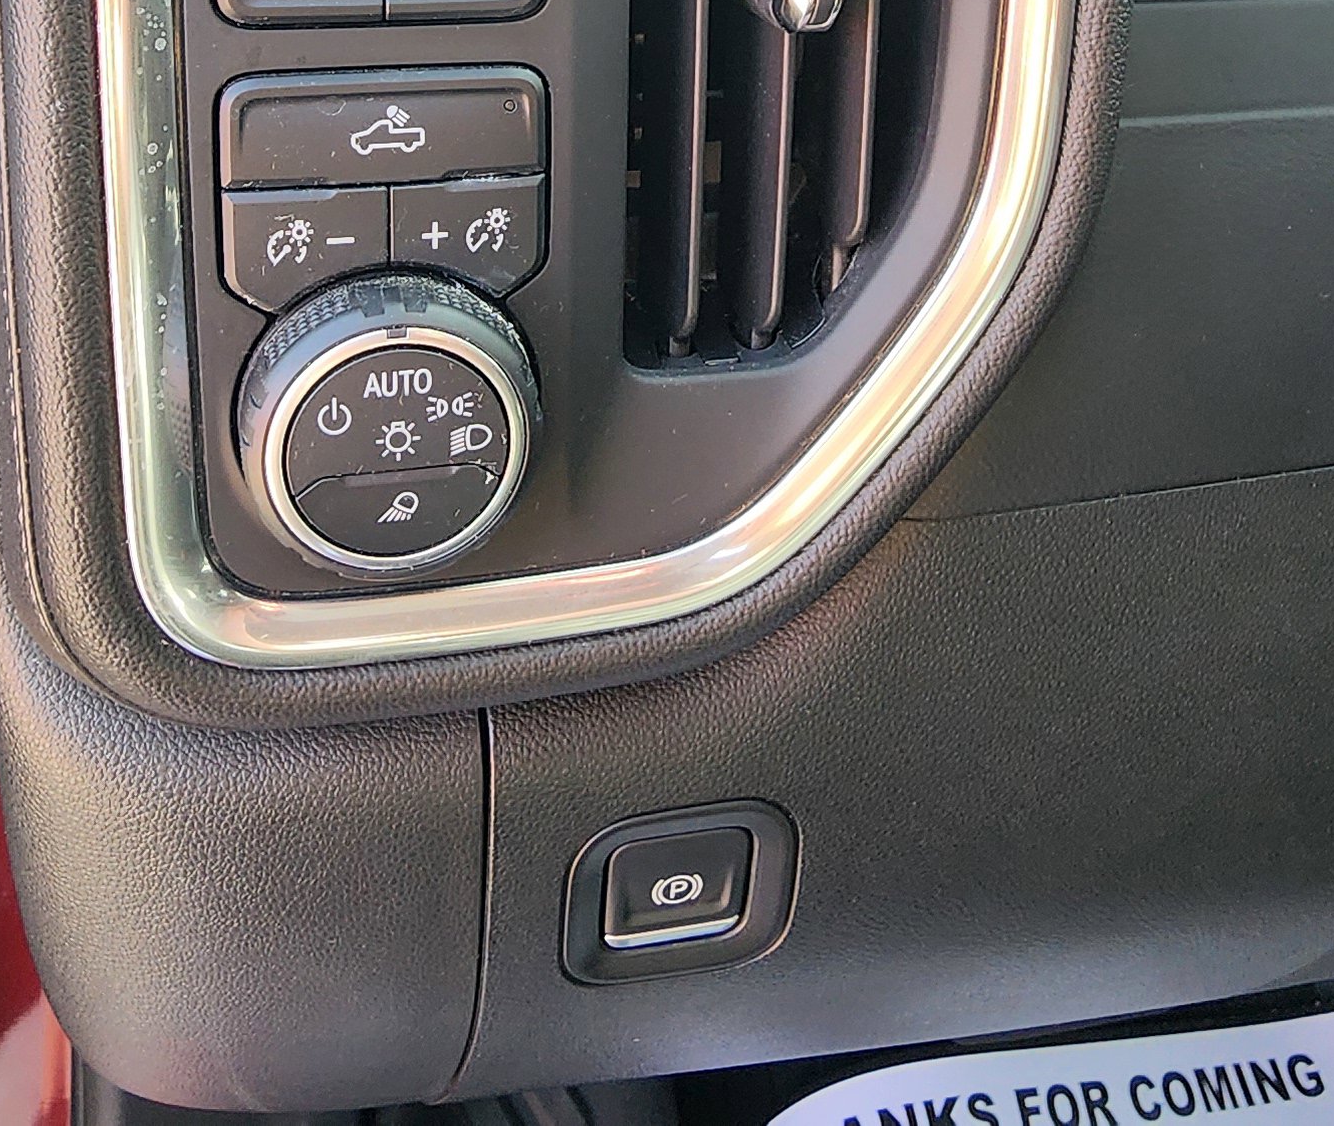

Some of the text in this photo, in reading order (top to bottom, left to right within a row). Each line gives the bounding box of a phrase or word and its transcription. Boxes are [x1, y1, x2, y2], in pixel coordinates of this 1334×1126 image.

[363, 368, 433, 400] AUTO
[1014, 1080, 1120, 1126] FOR
[1129, 1053, 1326, 1121] COMING
